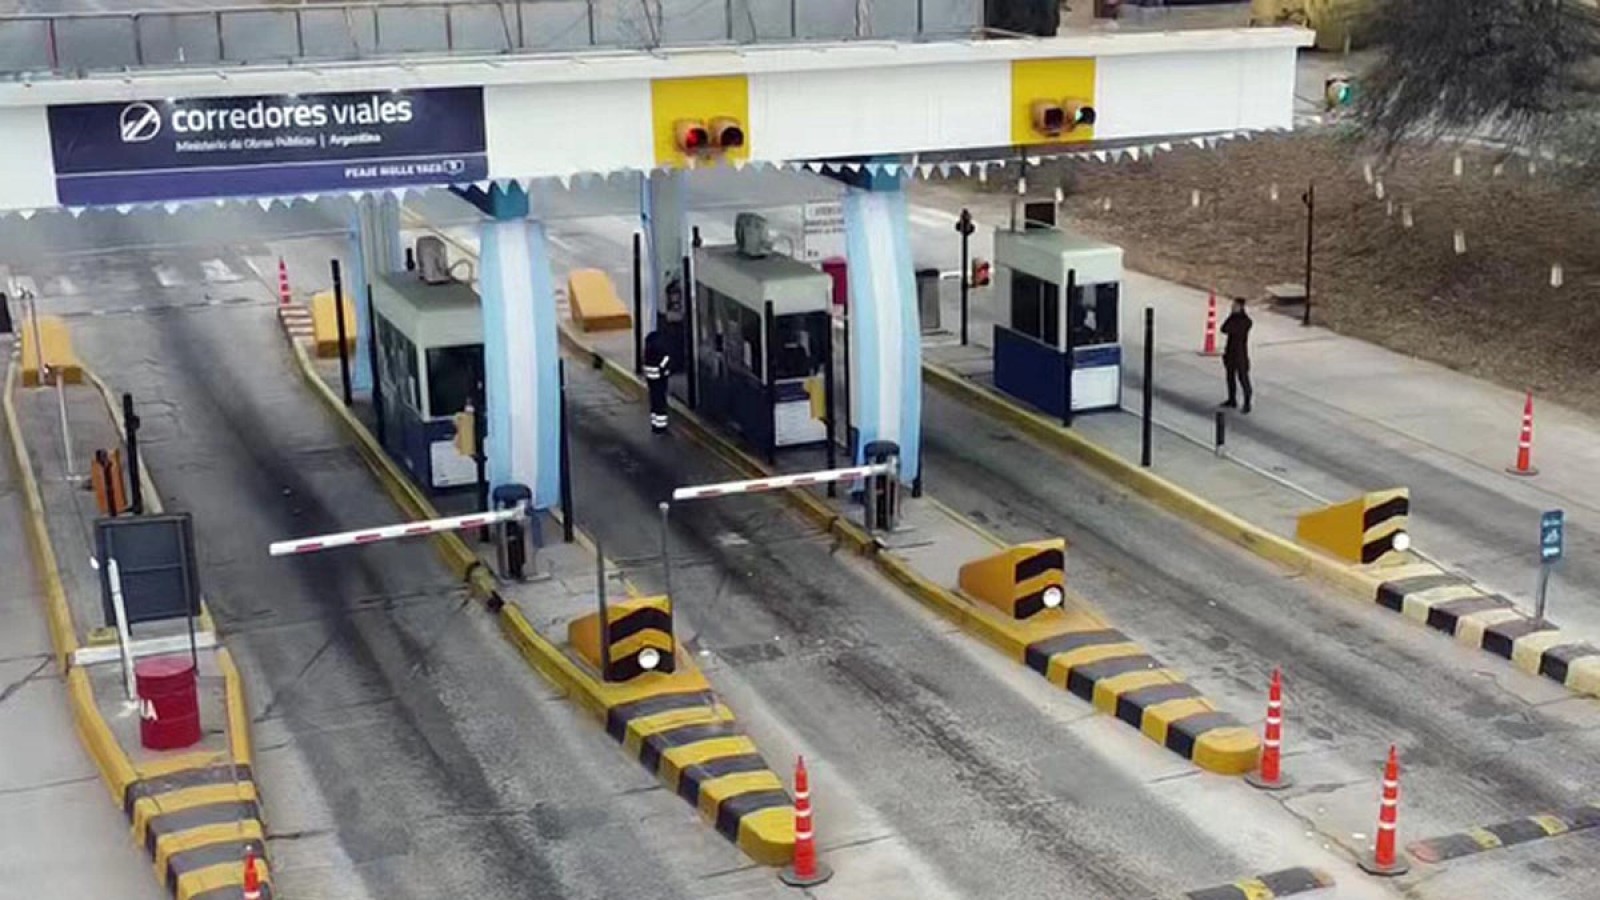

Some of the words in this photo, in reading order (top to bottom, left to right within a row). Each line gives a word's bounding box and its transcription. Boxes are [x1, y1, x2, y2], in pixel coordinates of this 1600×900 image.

[172, 100, 328, 133] corredores
[332, 95, 413, 124] viales
[244, 138, 275, 150] Obras
[329, 132, 381, 148] Argentina
